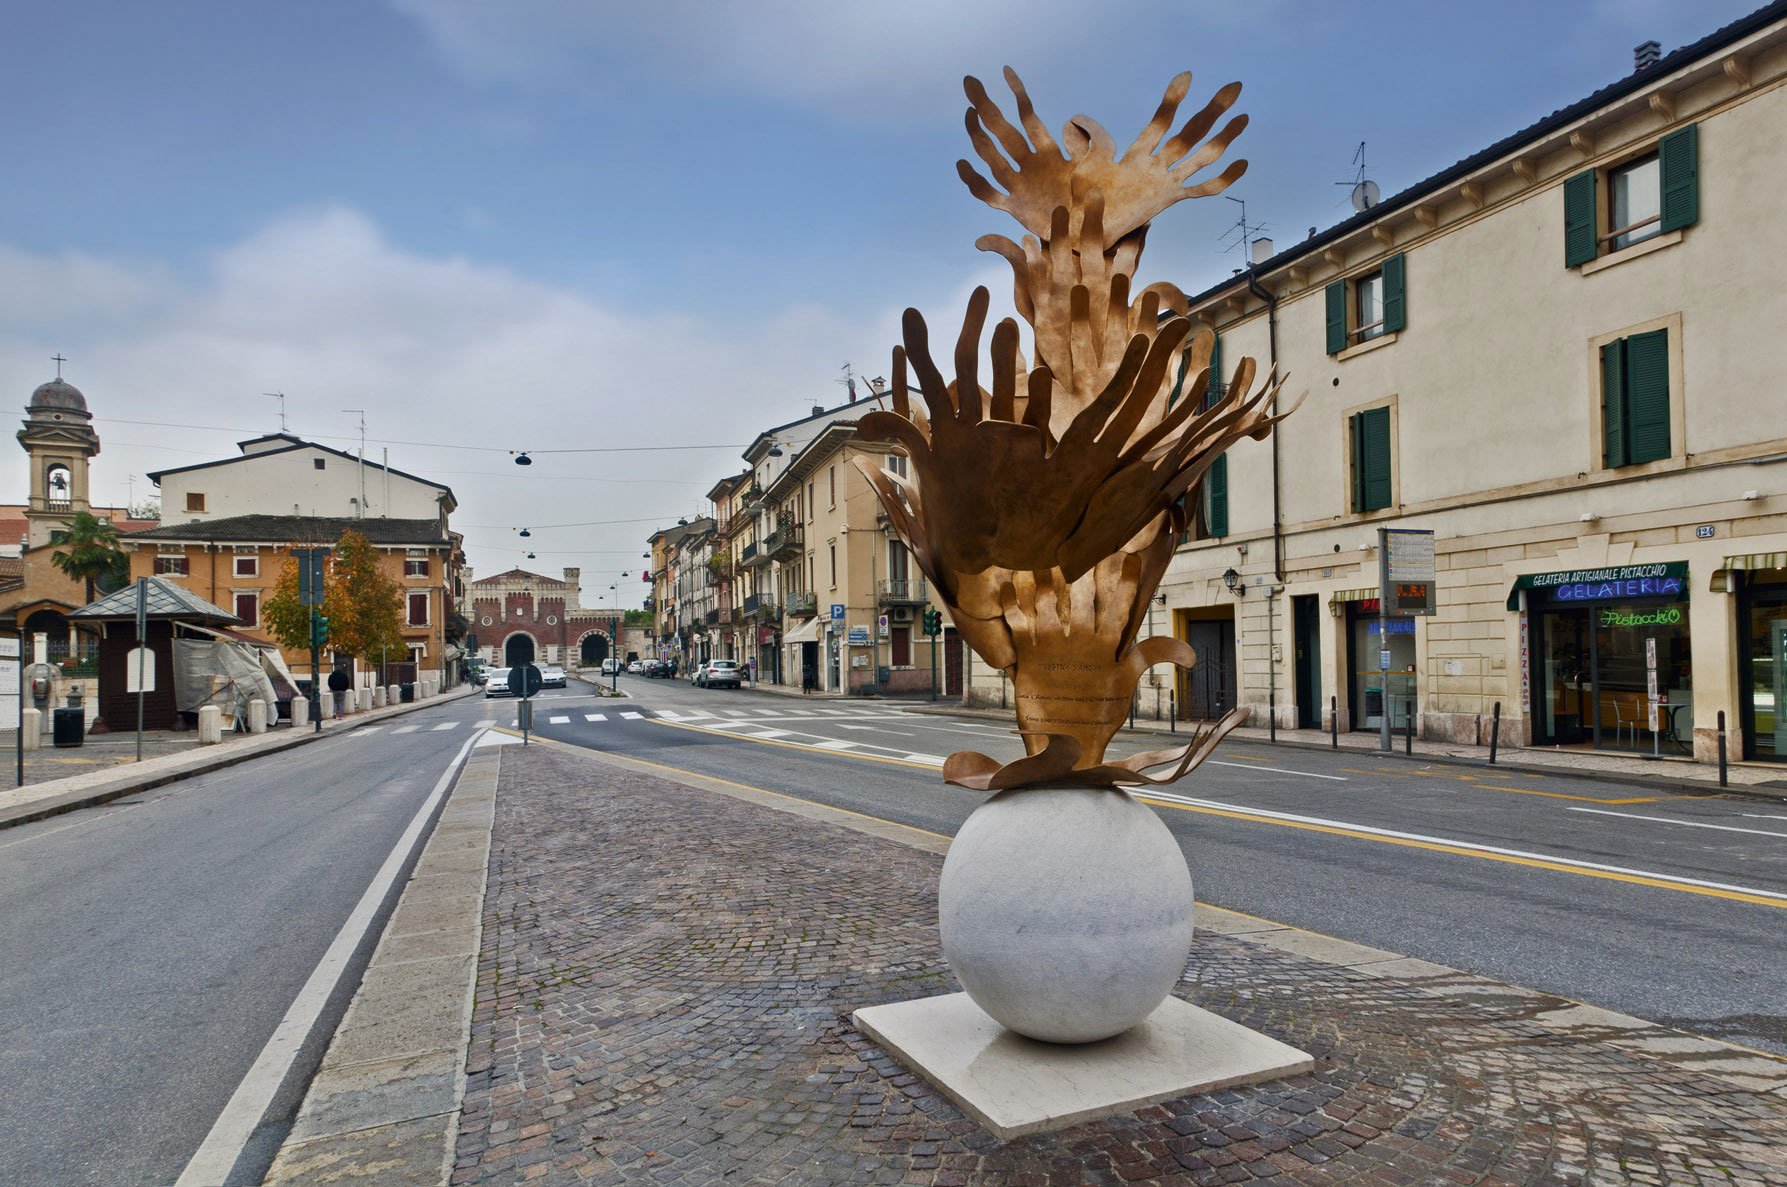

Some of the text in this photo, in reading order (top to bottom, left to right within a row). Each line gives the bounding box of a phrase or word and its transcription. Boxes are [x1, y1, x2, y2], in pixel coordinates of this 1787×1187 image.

[1533, 564, 1667, 586] GELATERIA ARTIGIANALE PISTACCHIO
[1558, 578, 1679, 599] GELATERIA
[833, 606, 843, 618] P
